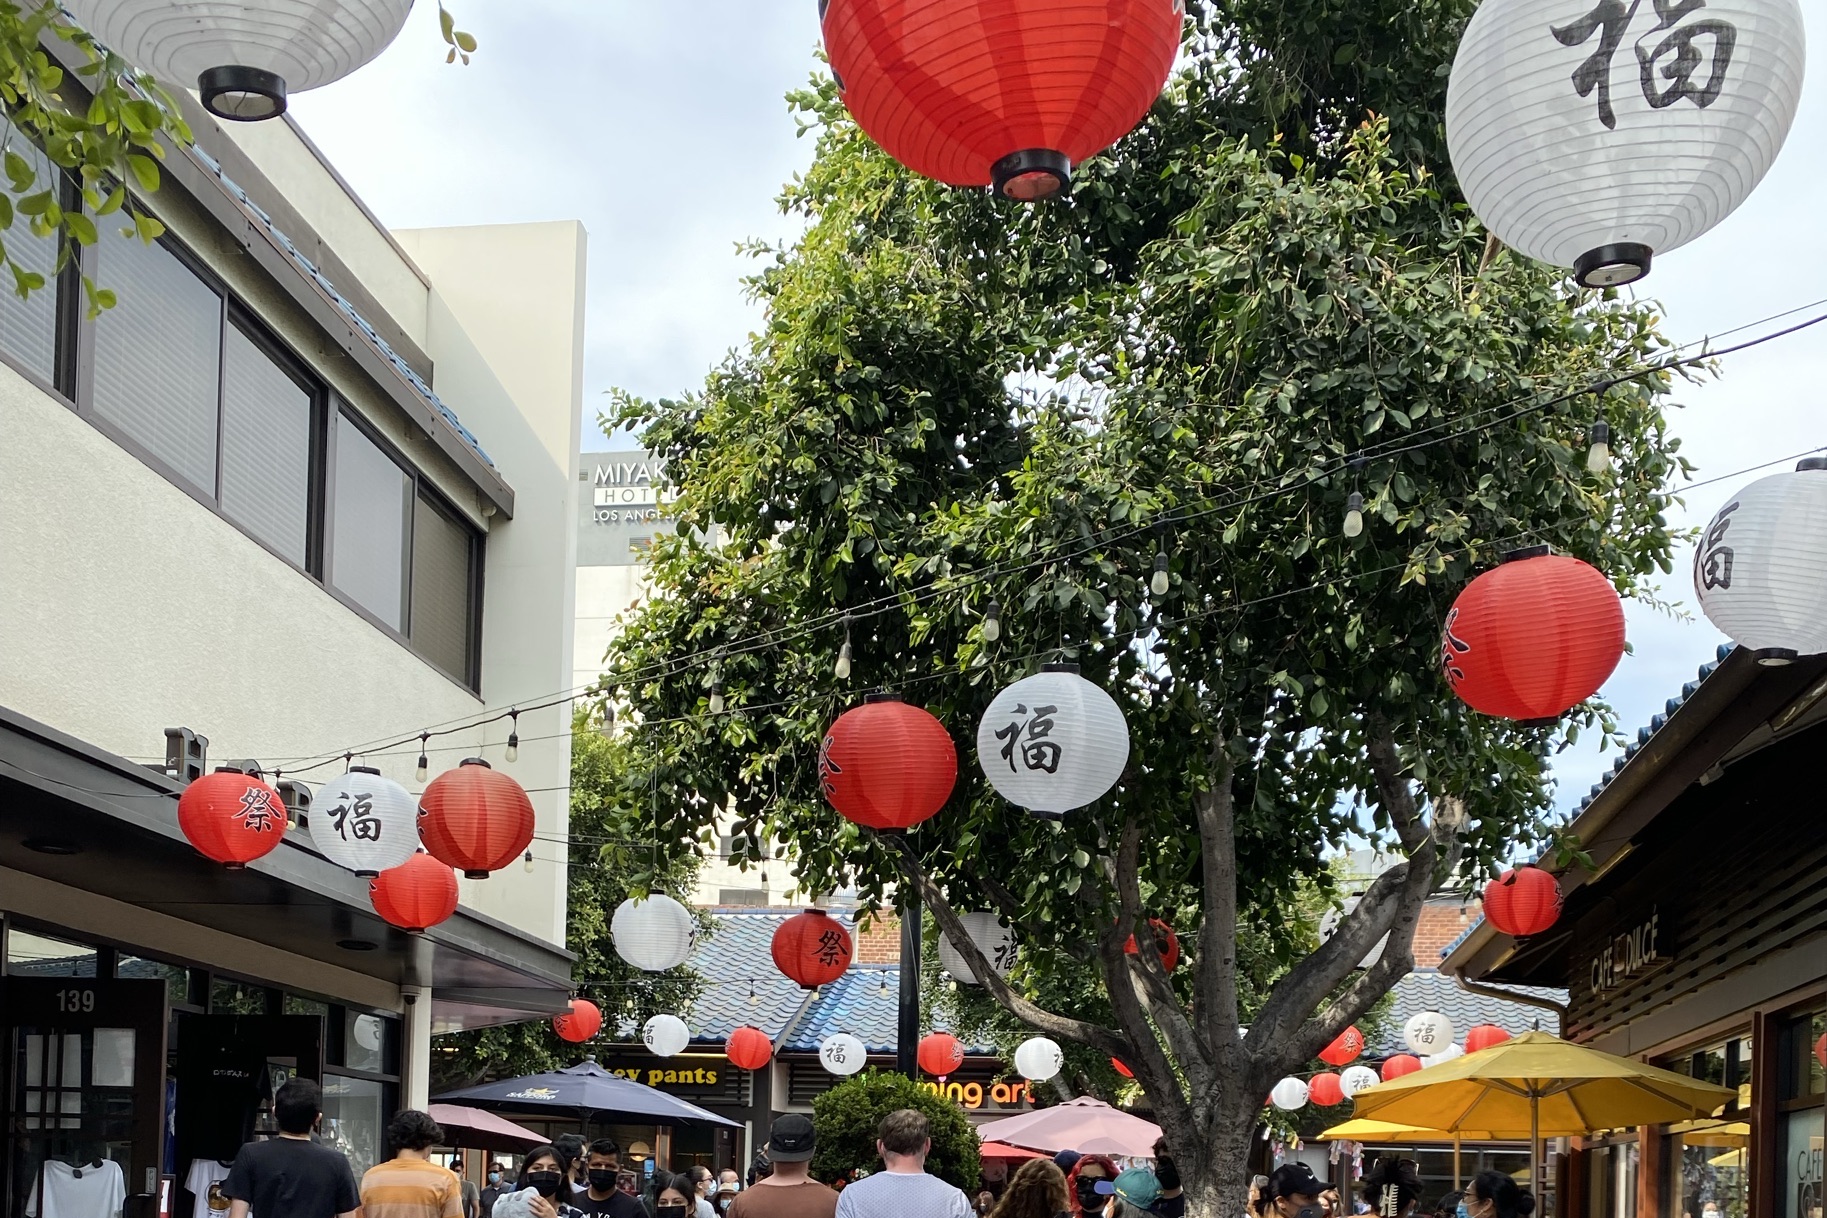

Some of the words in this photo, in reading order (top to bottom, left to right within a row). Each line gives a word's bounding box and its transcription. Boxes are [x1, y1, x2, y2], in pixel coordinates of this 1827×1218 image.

[1549, 0, 1737, 129] 福
[594, 462, 668, 484] MIYAK
[604, 488, 676, 502] HOTL
[593, 510, 618, 521] LOS
[994, 703, 1062, 773] 福
[231, 787, 281, 832] 祭
[326, 791, 382, 842] 福
[811, 929, 848, 967] 祭
[56, 989, 95, 1013] 139
[1414, 1022, 1436, 1045] 福
[825, 1042, 846, 1064] 福
[647, 1067, 718, 1087] pants
[991, 1079, 1036, 1104] art
